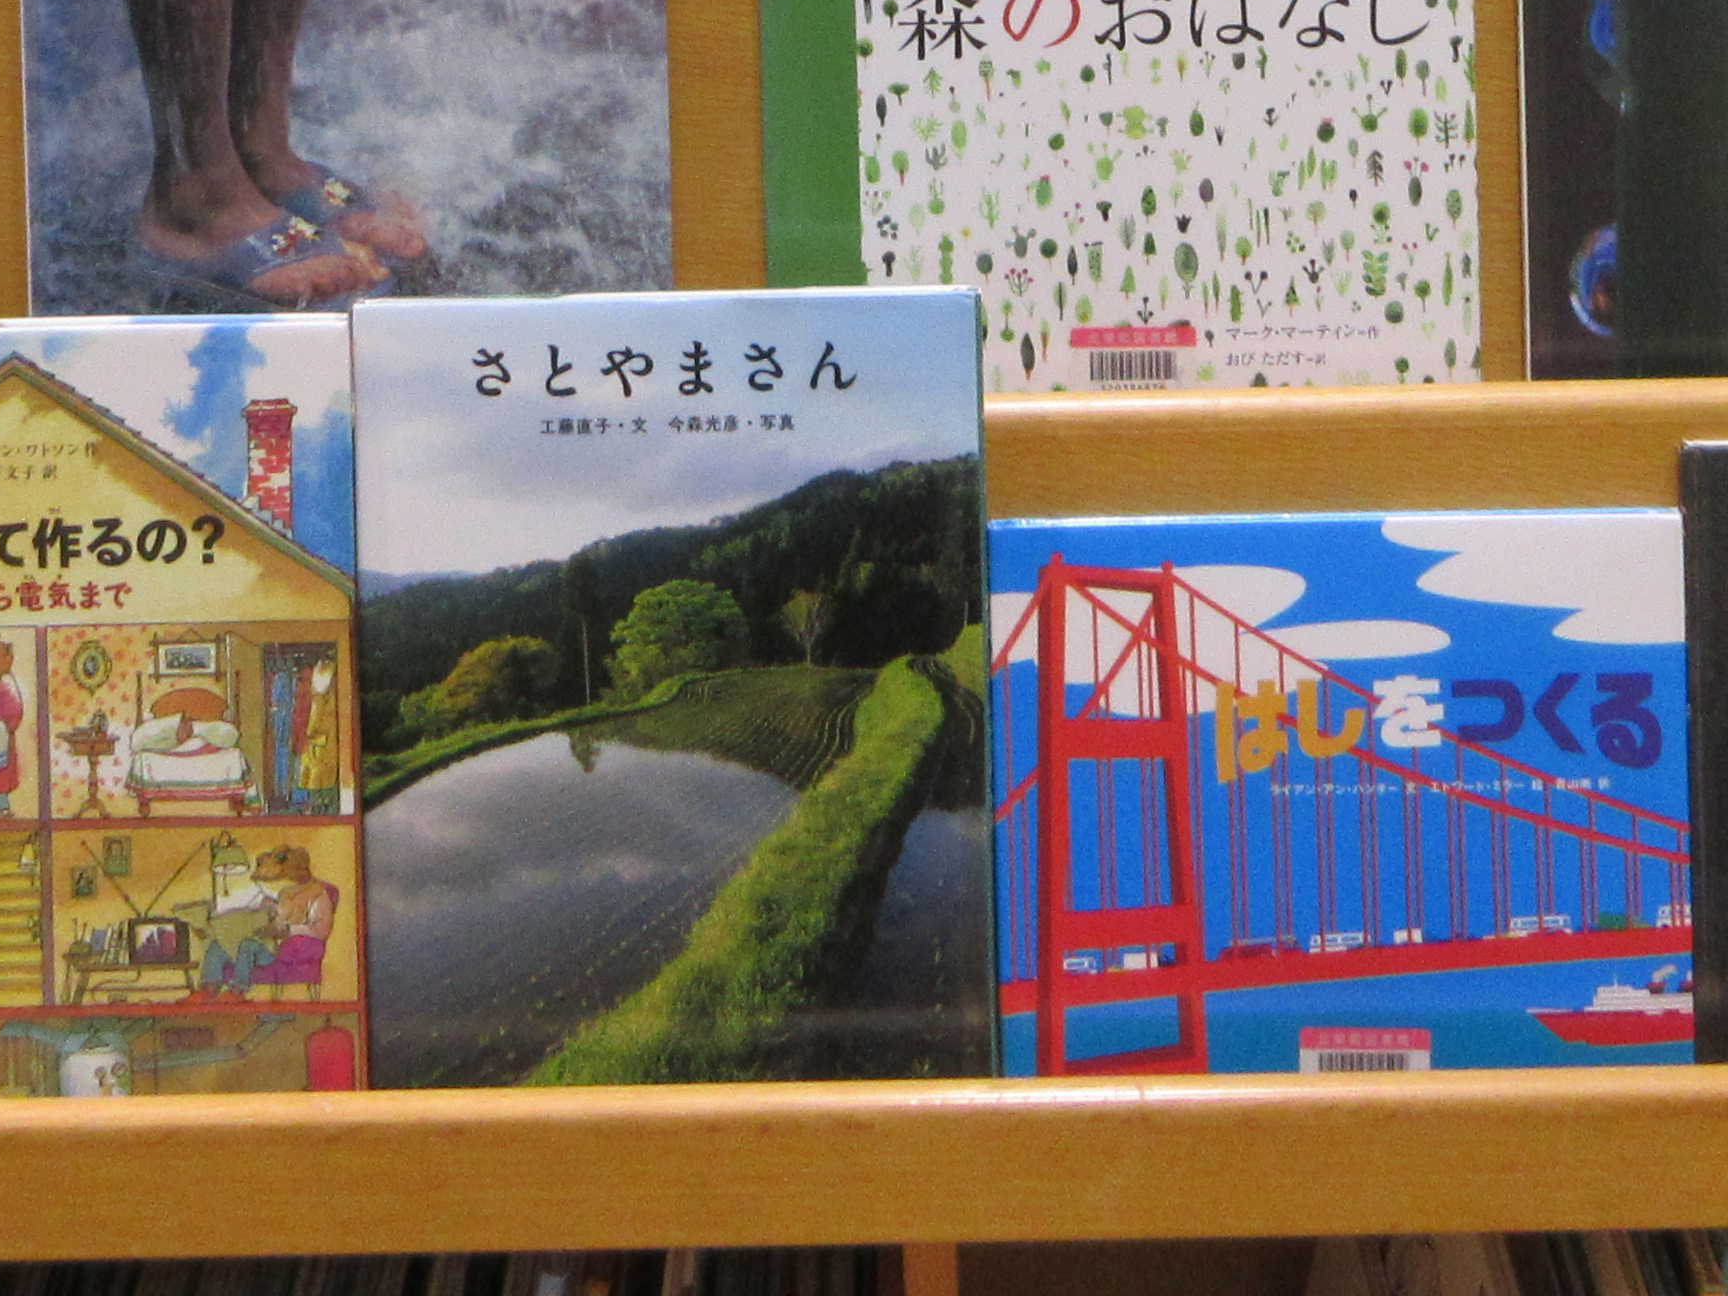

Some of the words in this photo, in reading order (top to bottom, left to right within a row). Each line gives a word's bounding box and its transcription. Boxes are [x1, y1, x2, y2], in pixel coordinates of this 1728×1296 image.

[469, 339, 859, 399] さとやまさん
[538, 414, 649, 437] 工藤直子・文
[667, 413, 797, 434] 今森光彦・写真
[1214, 671, 1664, 784] はしをつくる
